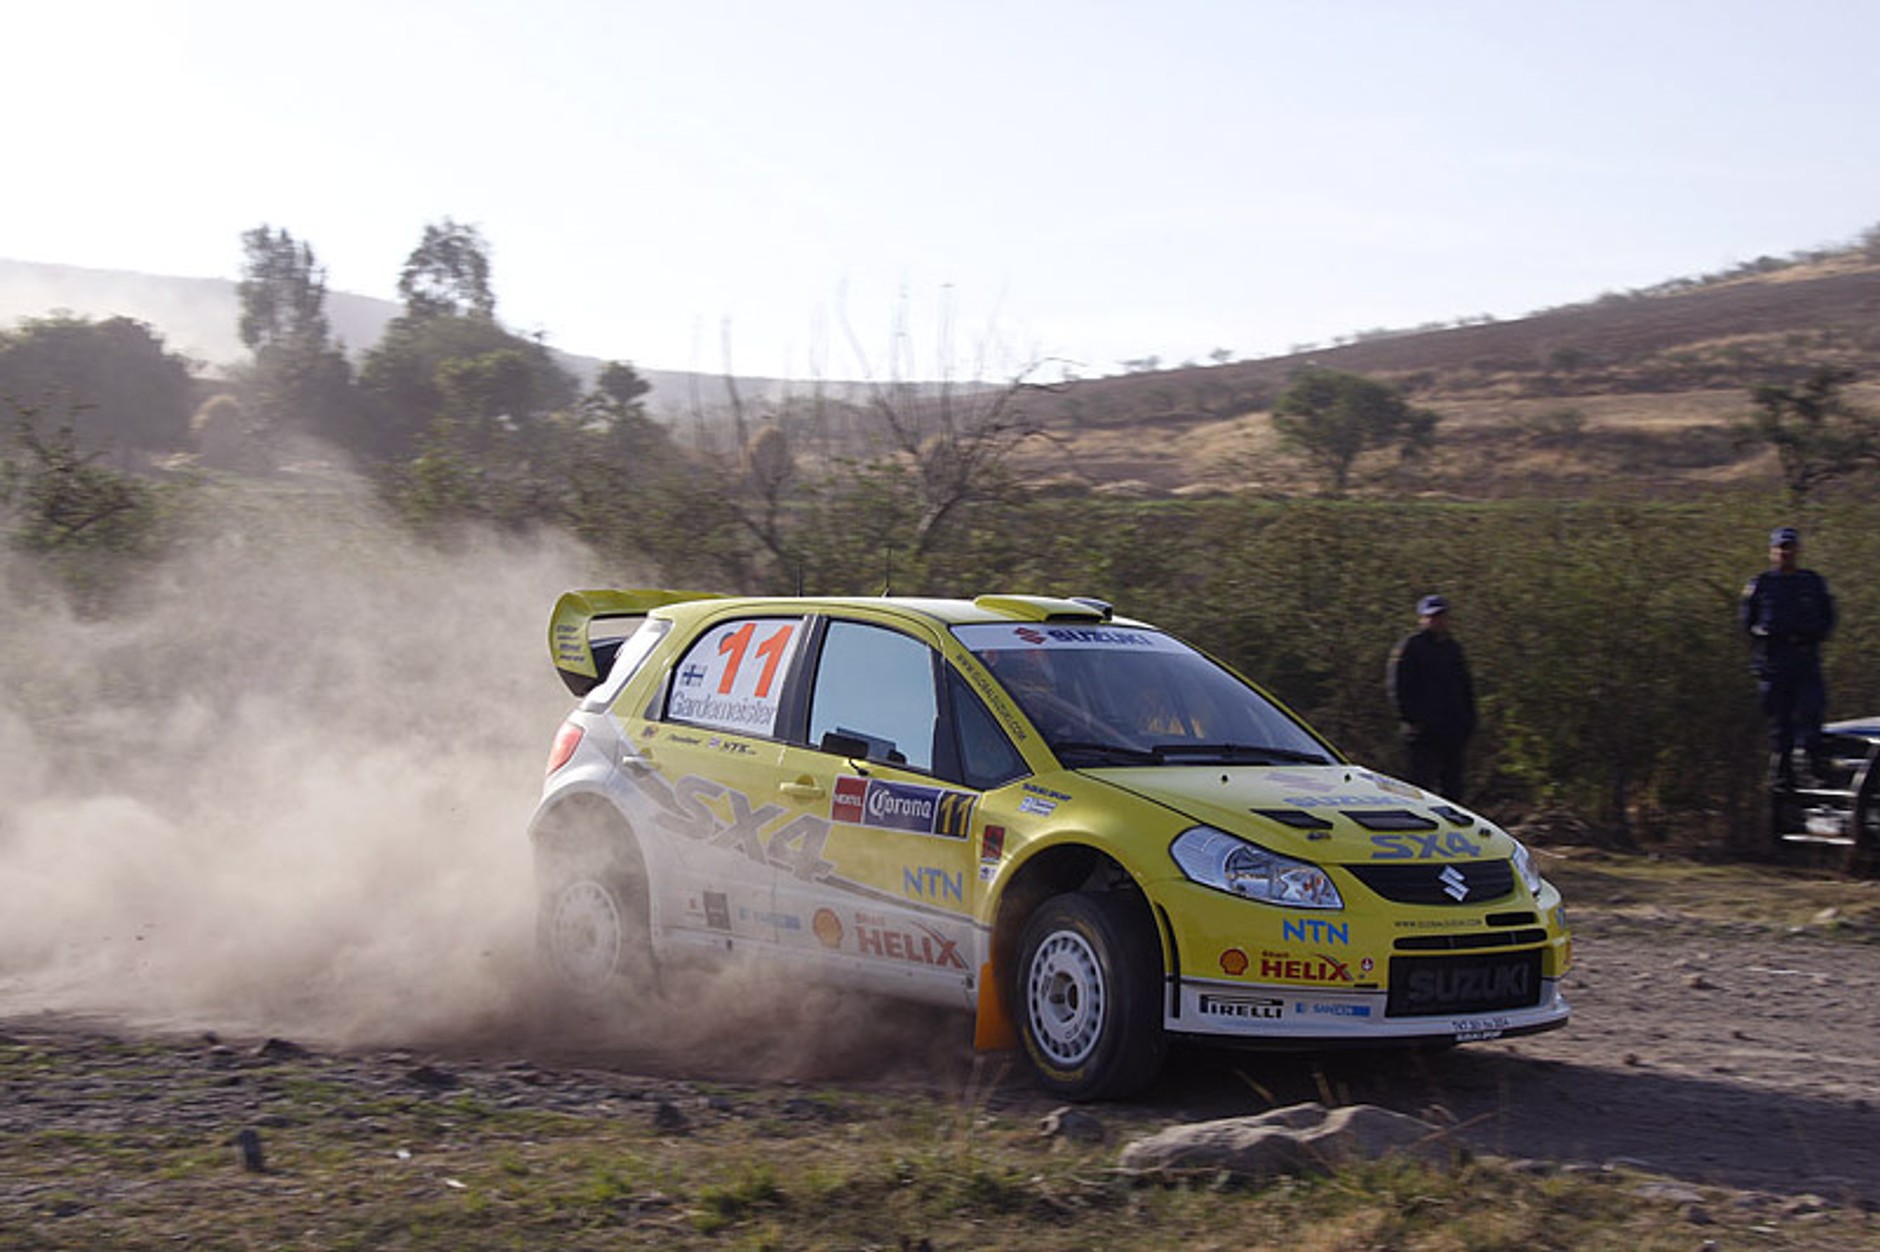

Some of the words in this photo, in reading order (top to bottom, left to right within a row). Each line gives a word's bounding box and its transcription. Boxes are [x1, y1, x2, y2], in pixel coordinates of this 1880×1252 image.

[718, 622, 795, 698] 11
[868, 788, 932, 821] Corona
[940, 793, 975, 837] 11
[648, 774, 837, 882] SX4
[1370, 833, 1481, 860] SX4
[902, 866, 963, 904] NTN
[855, 920, 969, 970] HELIX
[1282, 918, 1350, 945] NTN
[1260, 954, 1355, 982] HELIX
[1407, 961, 1529, 1002] SUZUKI
[1199, 993, 1284, 1019] PIRELLI
